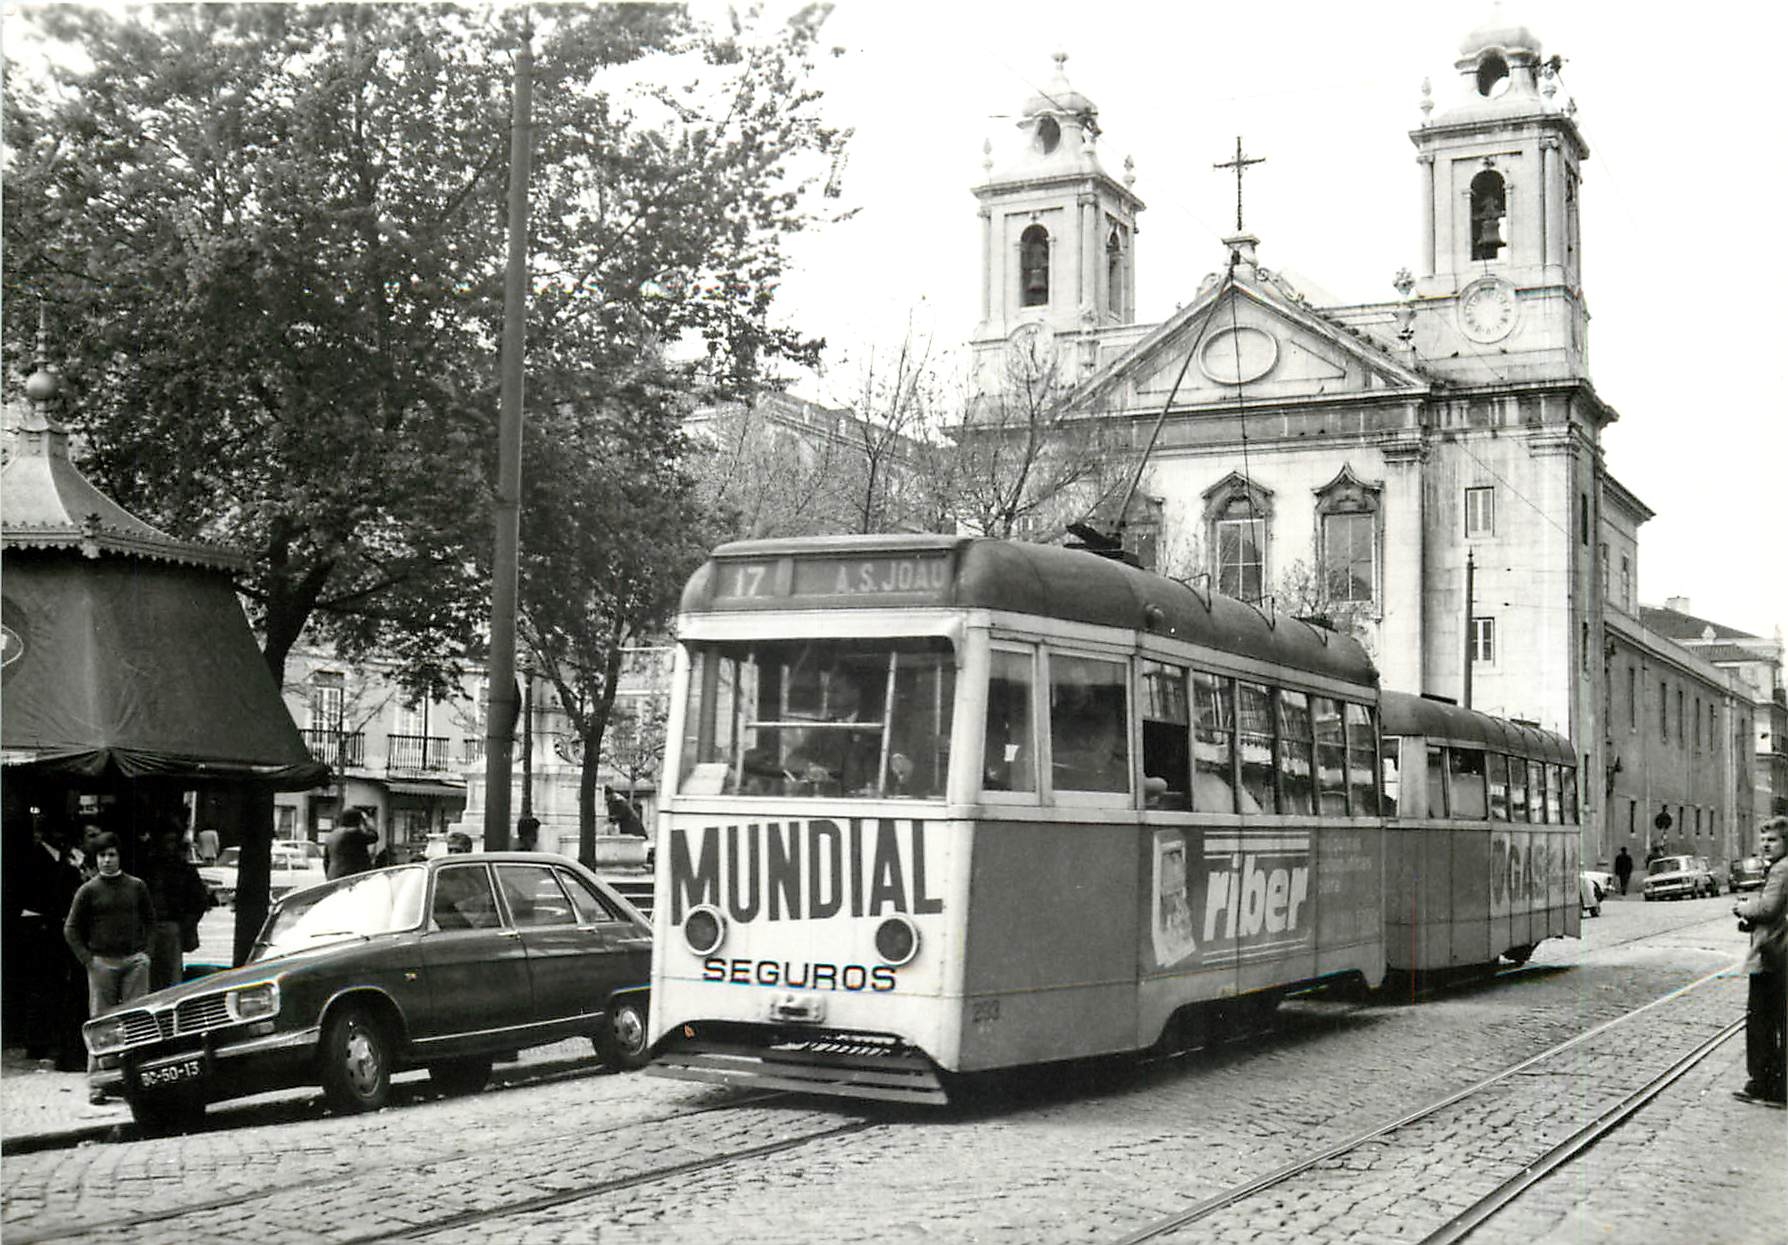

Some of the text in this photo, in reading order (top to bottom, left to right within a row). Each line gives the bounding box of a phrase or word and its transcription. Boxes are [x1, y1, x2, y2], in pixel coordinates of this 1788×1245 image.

[732, 566, 767, 598] 17
[669, 817, 944, 926] MUNDIAL
[1202, 853, 1309, 942] riber
[702, 957, 897, 992] SEGUROS
